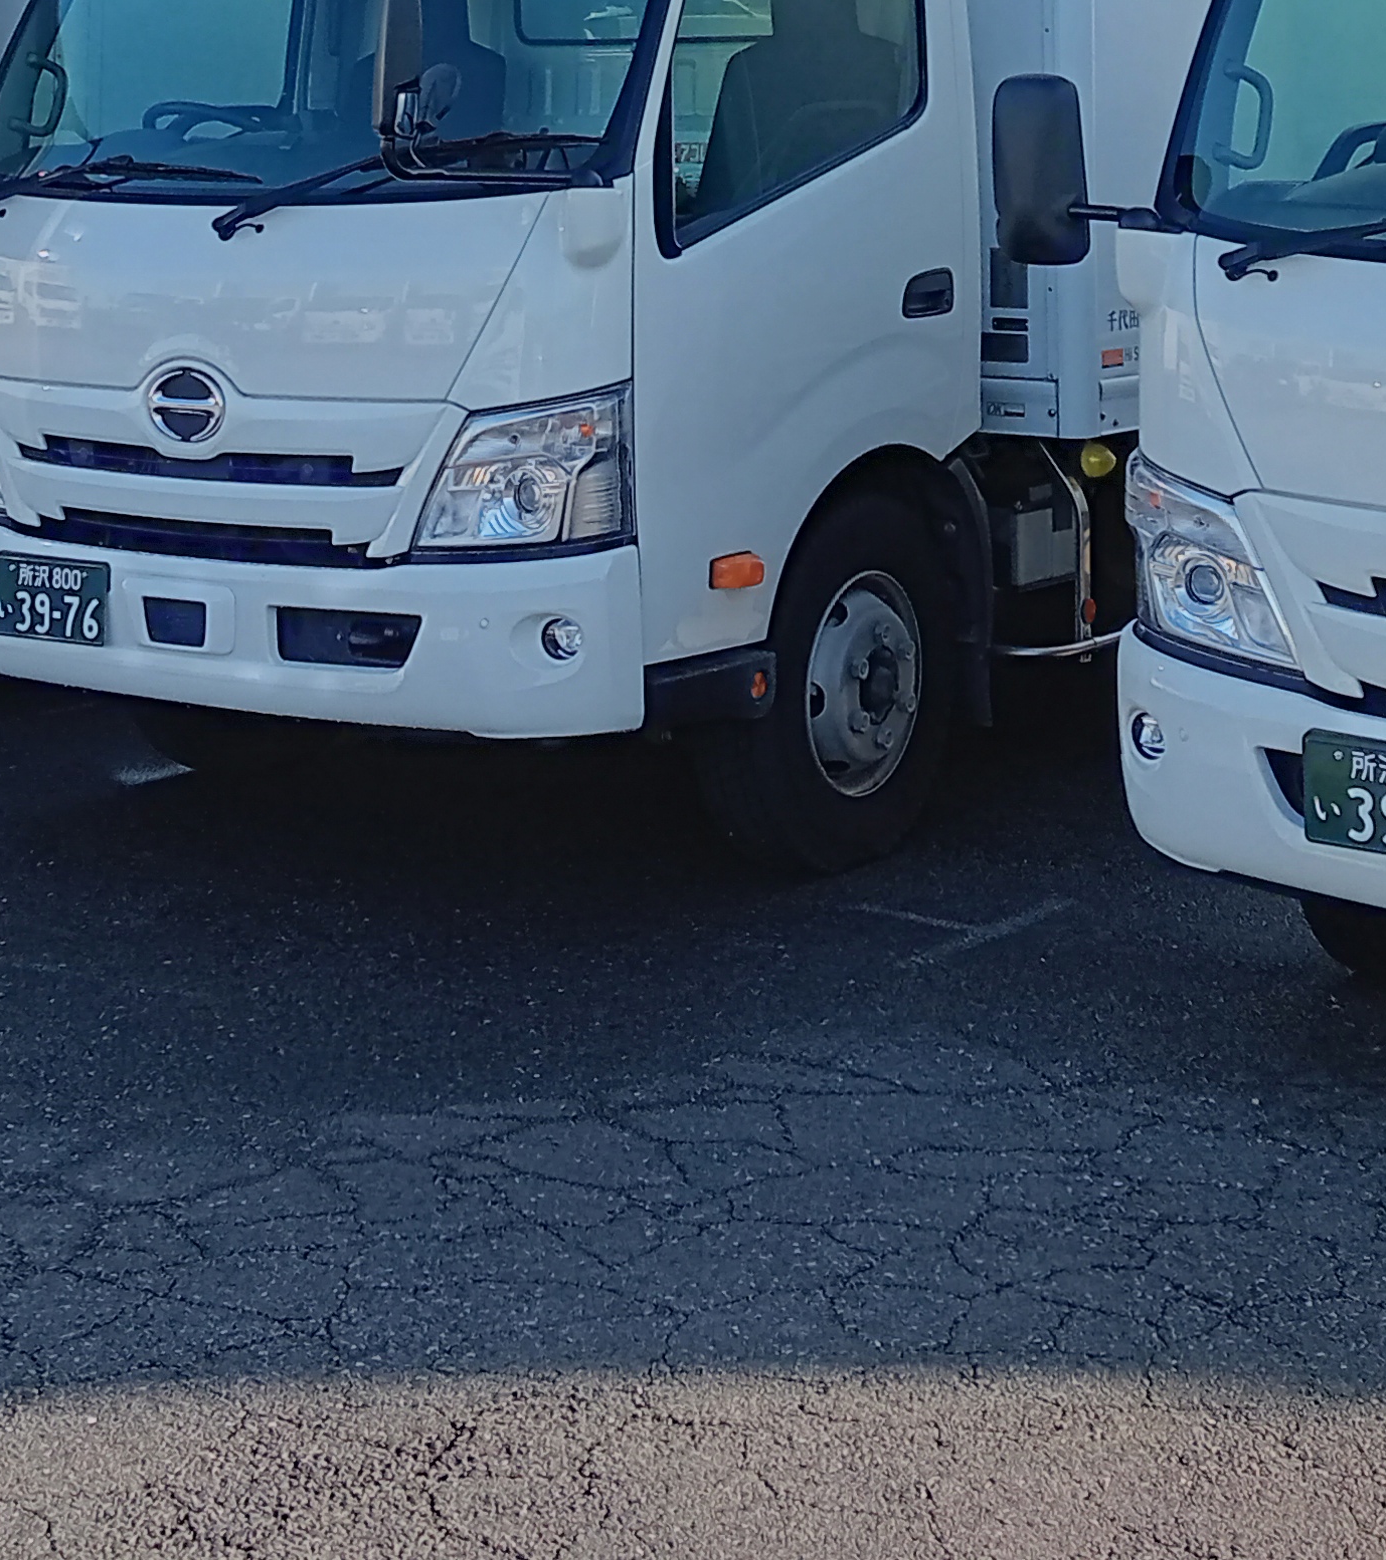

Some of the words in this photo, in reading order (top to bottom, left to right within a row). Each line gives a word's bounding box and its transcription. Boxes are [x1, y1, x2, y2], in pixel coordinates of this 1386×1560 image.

[17, 563, 50, 588] 所沢
[51, 567, 82, 591] 800
[15, 590, 100, 640] 39-76
[1312, 795, 1342, 821] い
